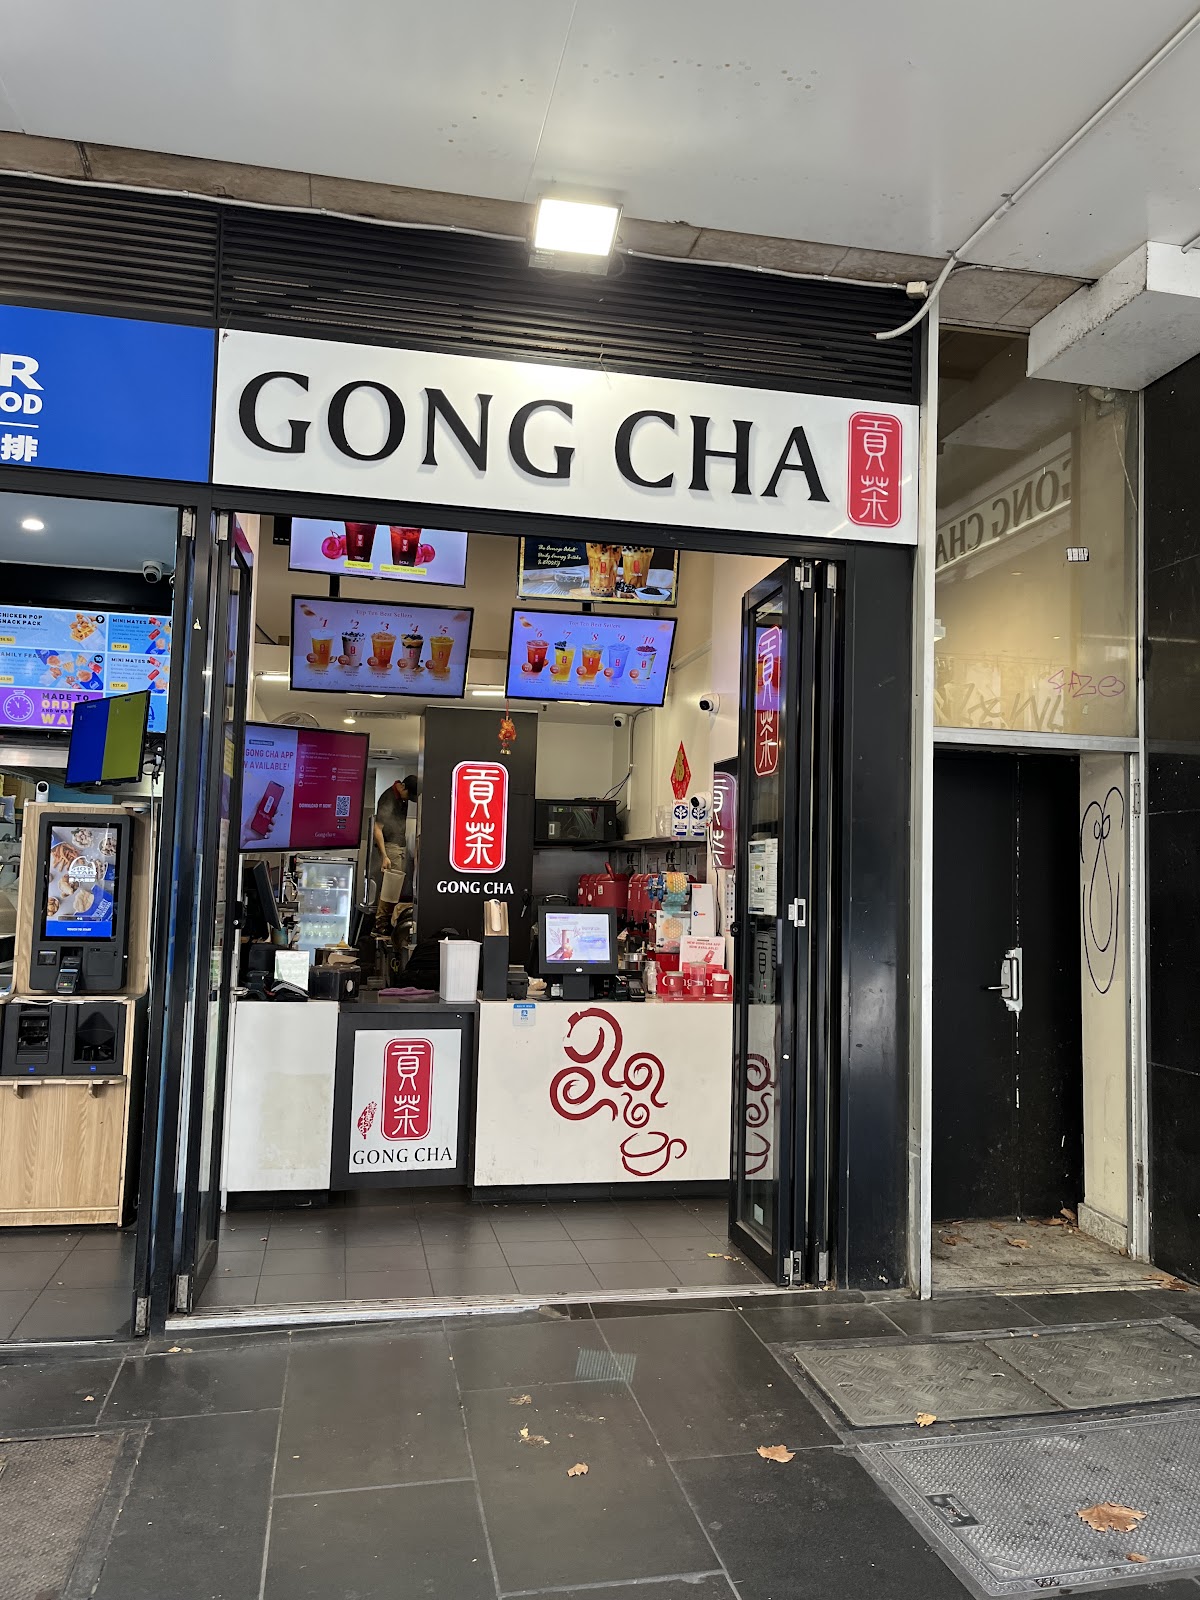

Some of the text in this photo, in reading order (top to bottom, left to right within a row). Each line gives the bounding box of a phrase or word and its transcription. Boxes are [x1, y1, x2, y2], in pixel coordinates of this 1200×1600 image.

[1, 433, 38, 462] 排
[239, 371, 830, 502] GONG CHA
[857, 419, 893, 521] 貢茶
[41, 713, 73, 725] WA
[245, 748, 264, 758] GONG
[265, 750, 279, 758] CHA
[281, 751, 294, 759] APP
[250, 761, 290, 771] AVAILABLE!
[463, 768, 500, 865] 貢茶
[437, 880, 514, 895] GONG CHA
[391, 1045, 425, 1135] 貢茶
[353, 1147, 453, 1164] GONG CHA
